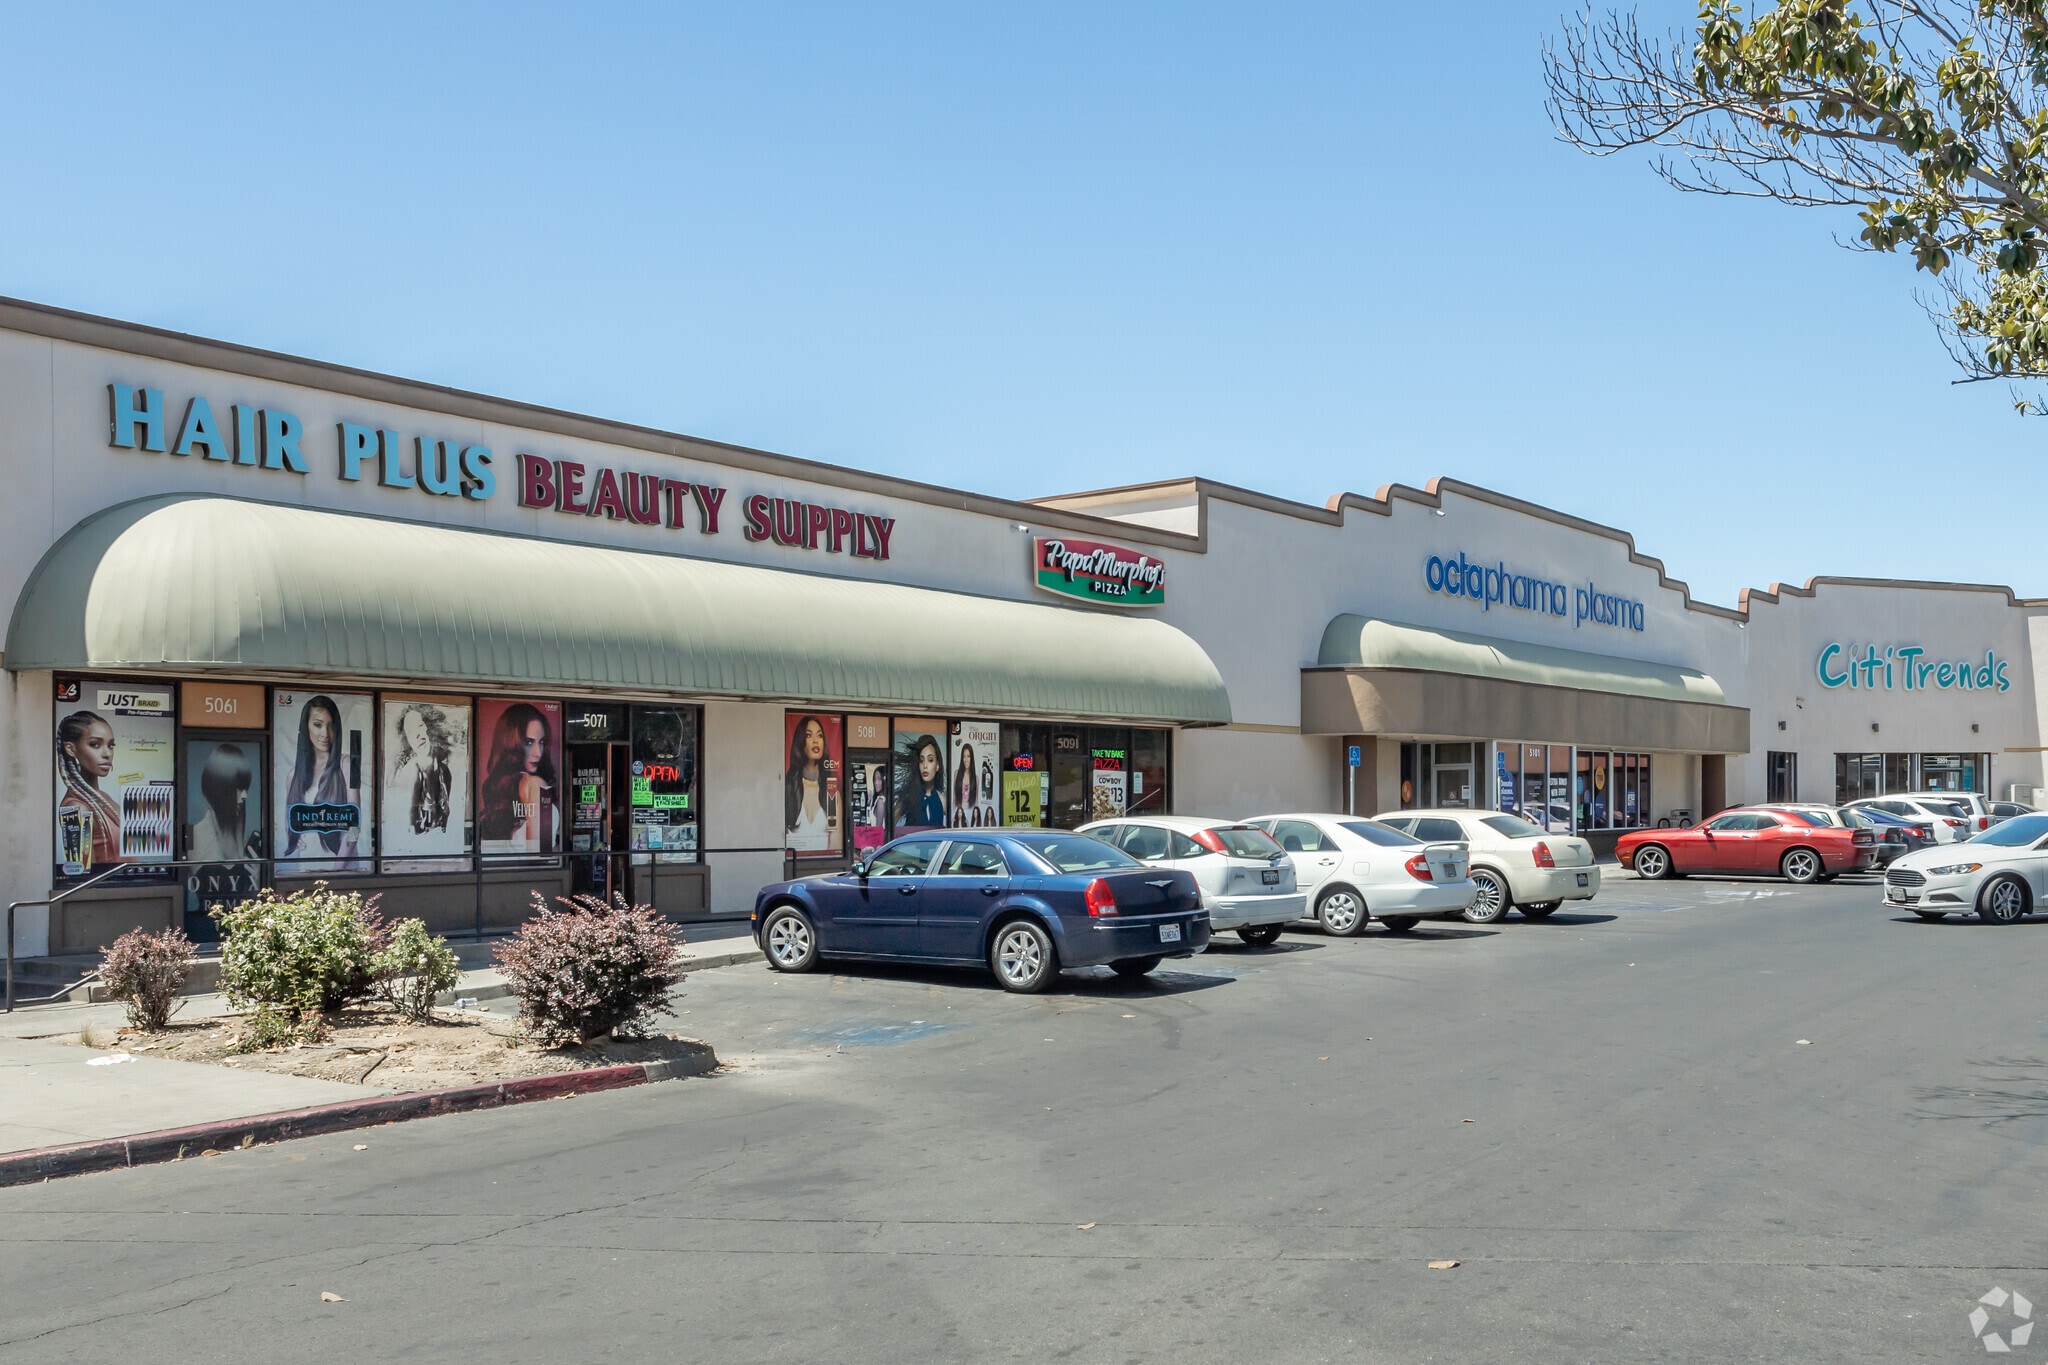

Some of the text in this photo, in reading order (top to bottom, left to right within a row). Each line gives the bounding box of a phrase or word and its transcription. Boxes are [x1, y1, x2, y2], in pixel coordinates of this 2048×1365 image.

[107, 383, 497, 501] HAIR PLUS
[516, 453, 896, 561] BEAUTY SUPPLY
[1044, 539, 1166, 594] Papa Murphy's
[1094, 581, 1127, 596] PIZZA
[1423, 551, 1645, 632] octapharma plasma
[1817, 642, 2011, 693] Citi Trends
[103, 693, 159, 708] JUST BRAID
[204, 696, 238, 714] 5061
[583, 713, 608, 728] 5071
[857, 725, 876, 738] 5081
[1057, 737, 1079, 749] 5091
[1091, 749, 1104, 758] TAKE
[1111, 749, 1125, 759] BAKE
[1529, 748, 1541, 758] 5101
[823, 759, 840, 769] GEM
[1013, 757, 1033, 768] OPEN
[1093, 758, 1121, 770] PIZZA
[643, 765, 679, 781] OPEN
[1098, 777, 1121, 785] COWBOY
[1010, 790, 1030, 812] $12
[1111, 787, 1123, 803] $13
[512, 800, 535, 818] VELVET
[1008, 814, 1036, 823] TUESDAY
[187, 875, 260, 893] ONYX
